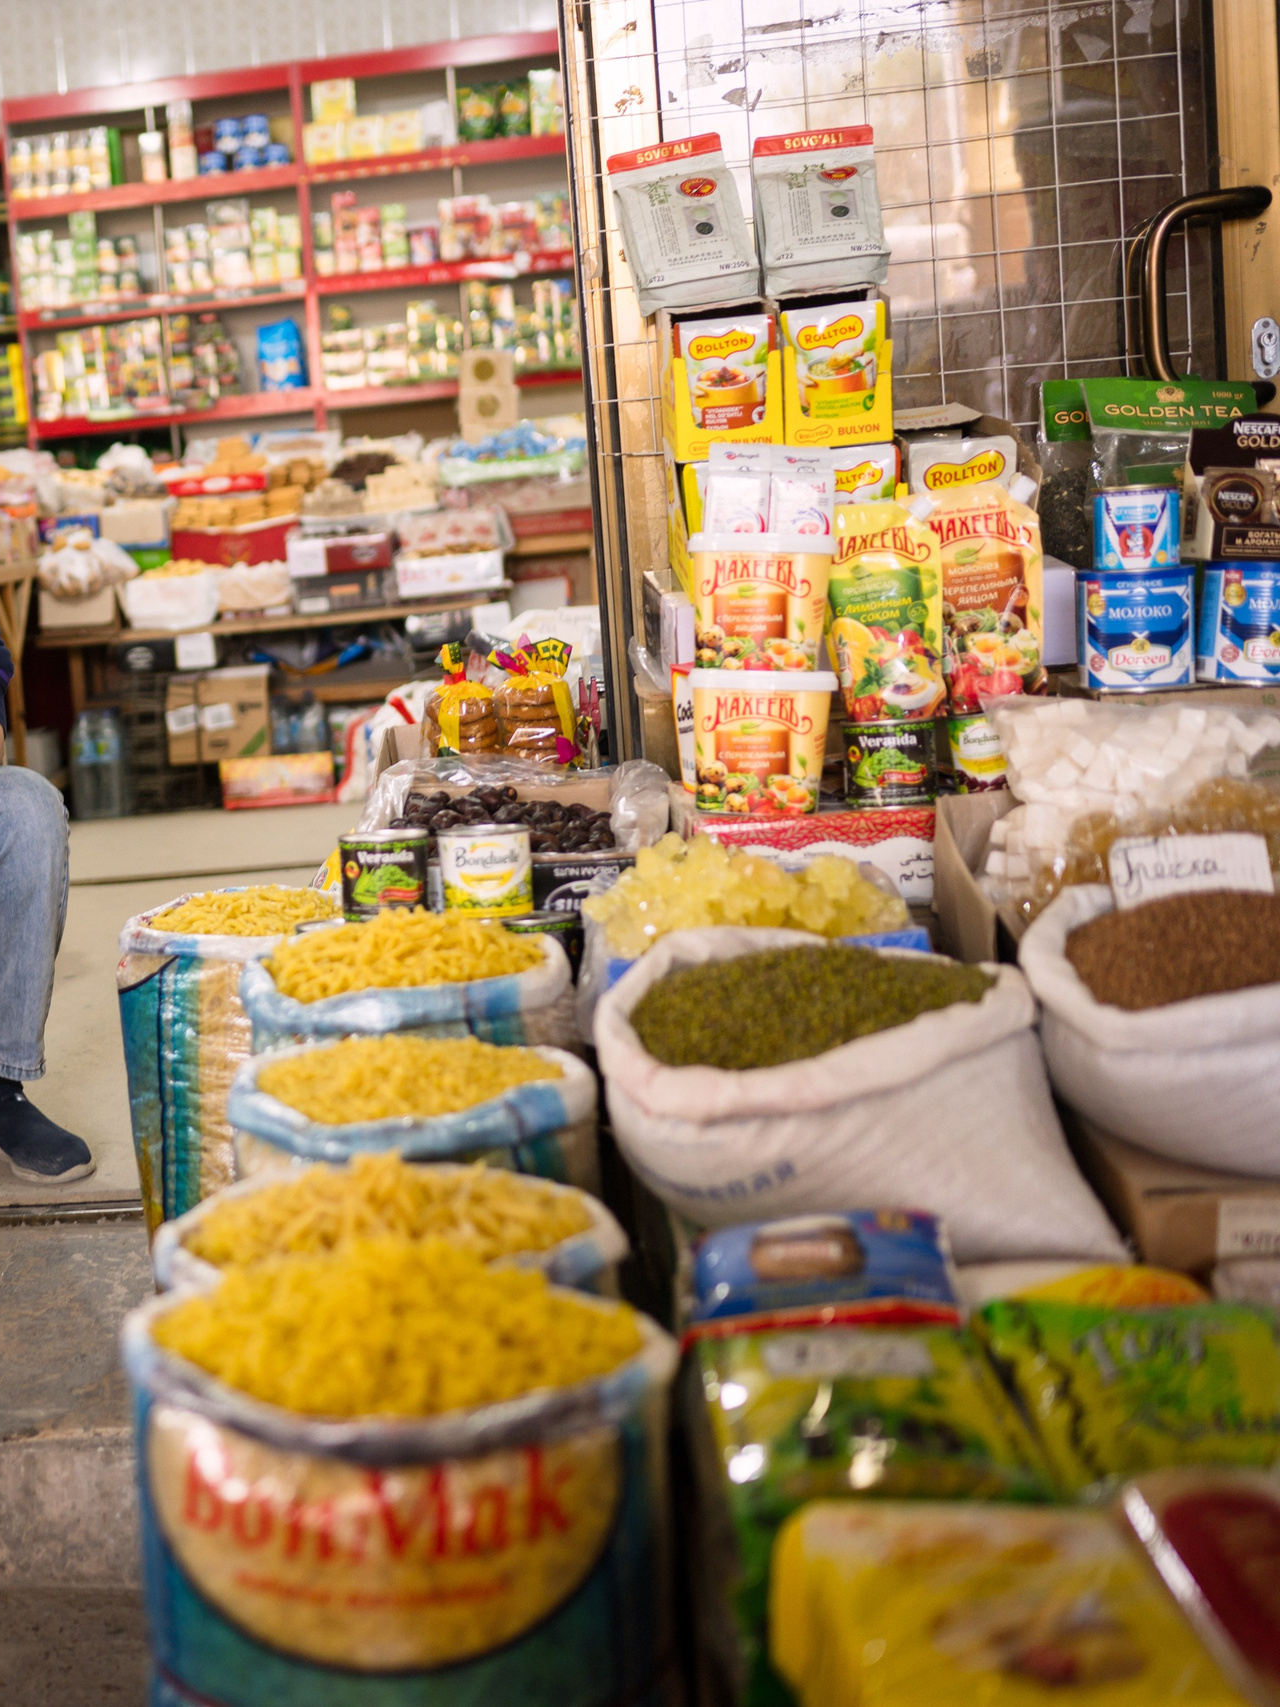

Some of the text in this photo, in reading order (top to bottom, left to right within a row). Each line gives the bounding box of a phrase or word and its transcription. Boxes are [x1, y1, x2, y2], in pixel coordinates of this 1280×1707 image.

[784, 133, 843, 150] SOVG'ALI
[636, 142, 693, 164] SOVG'ALI
[803, 324, 857, 345] ROLLTON
[696, 335, 749, 355] ROLLTON
[1104, 403, 1244, 419] GOLDEN TEA
[837, 423, 881, 437] BULYON
[1236, 434, 1280, 449] GOLD
[929, 461, 998, 489] ROLLTON
[845, 597, 912, 613] ЛИМОННЫМ
[1108, 604, 1173, 620] МОЛОКО
[860, 610, 901, 623] СОКОМ
[1114, 652, 1167, 667] Doreen
[858, 733, 918, 749] Veranda
[357, 850, 415, 865] Veranda
[453, 845, 519, 870] Bonduelle
